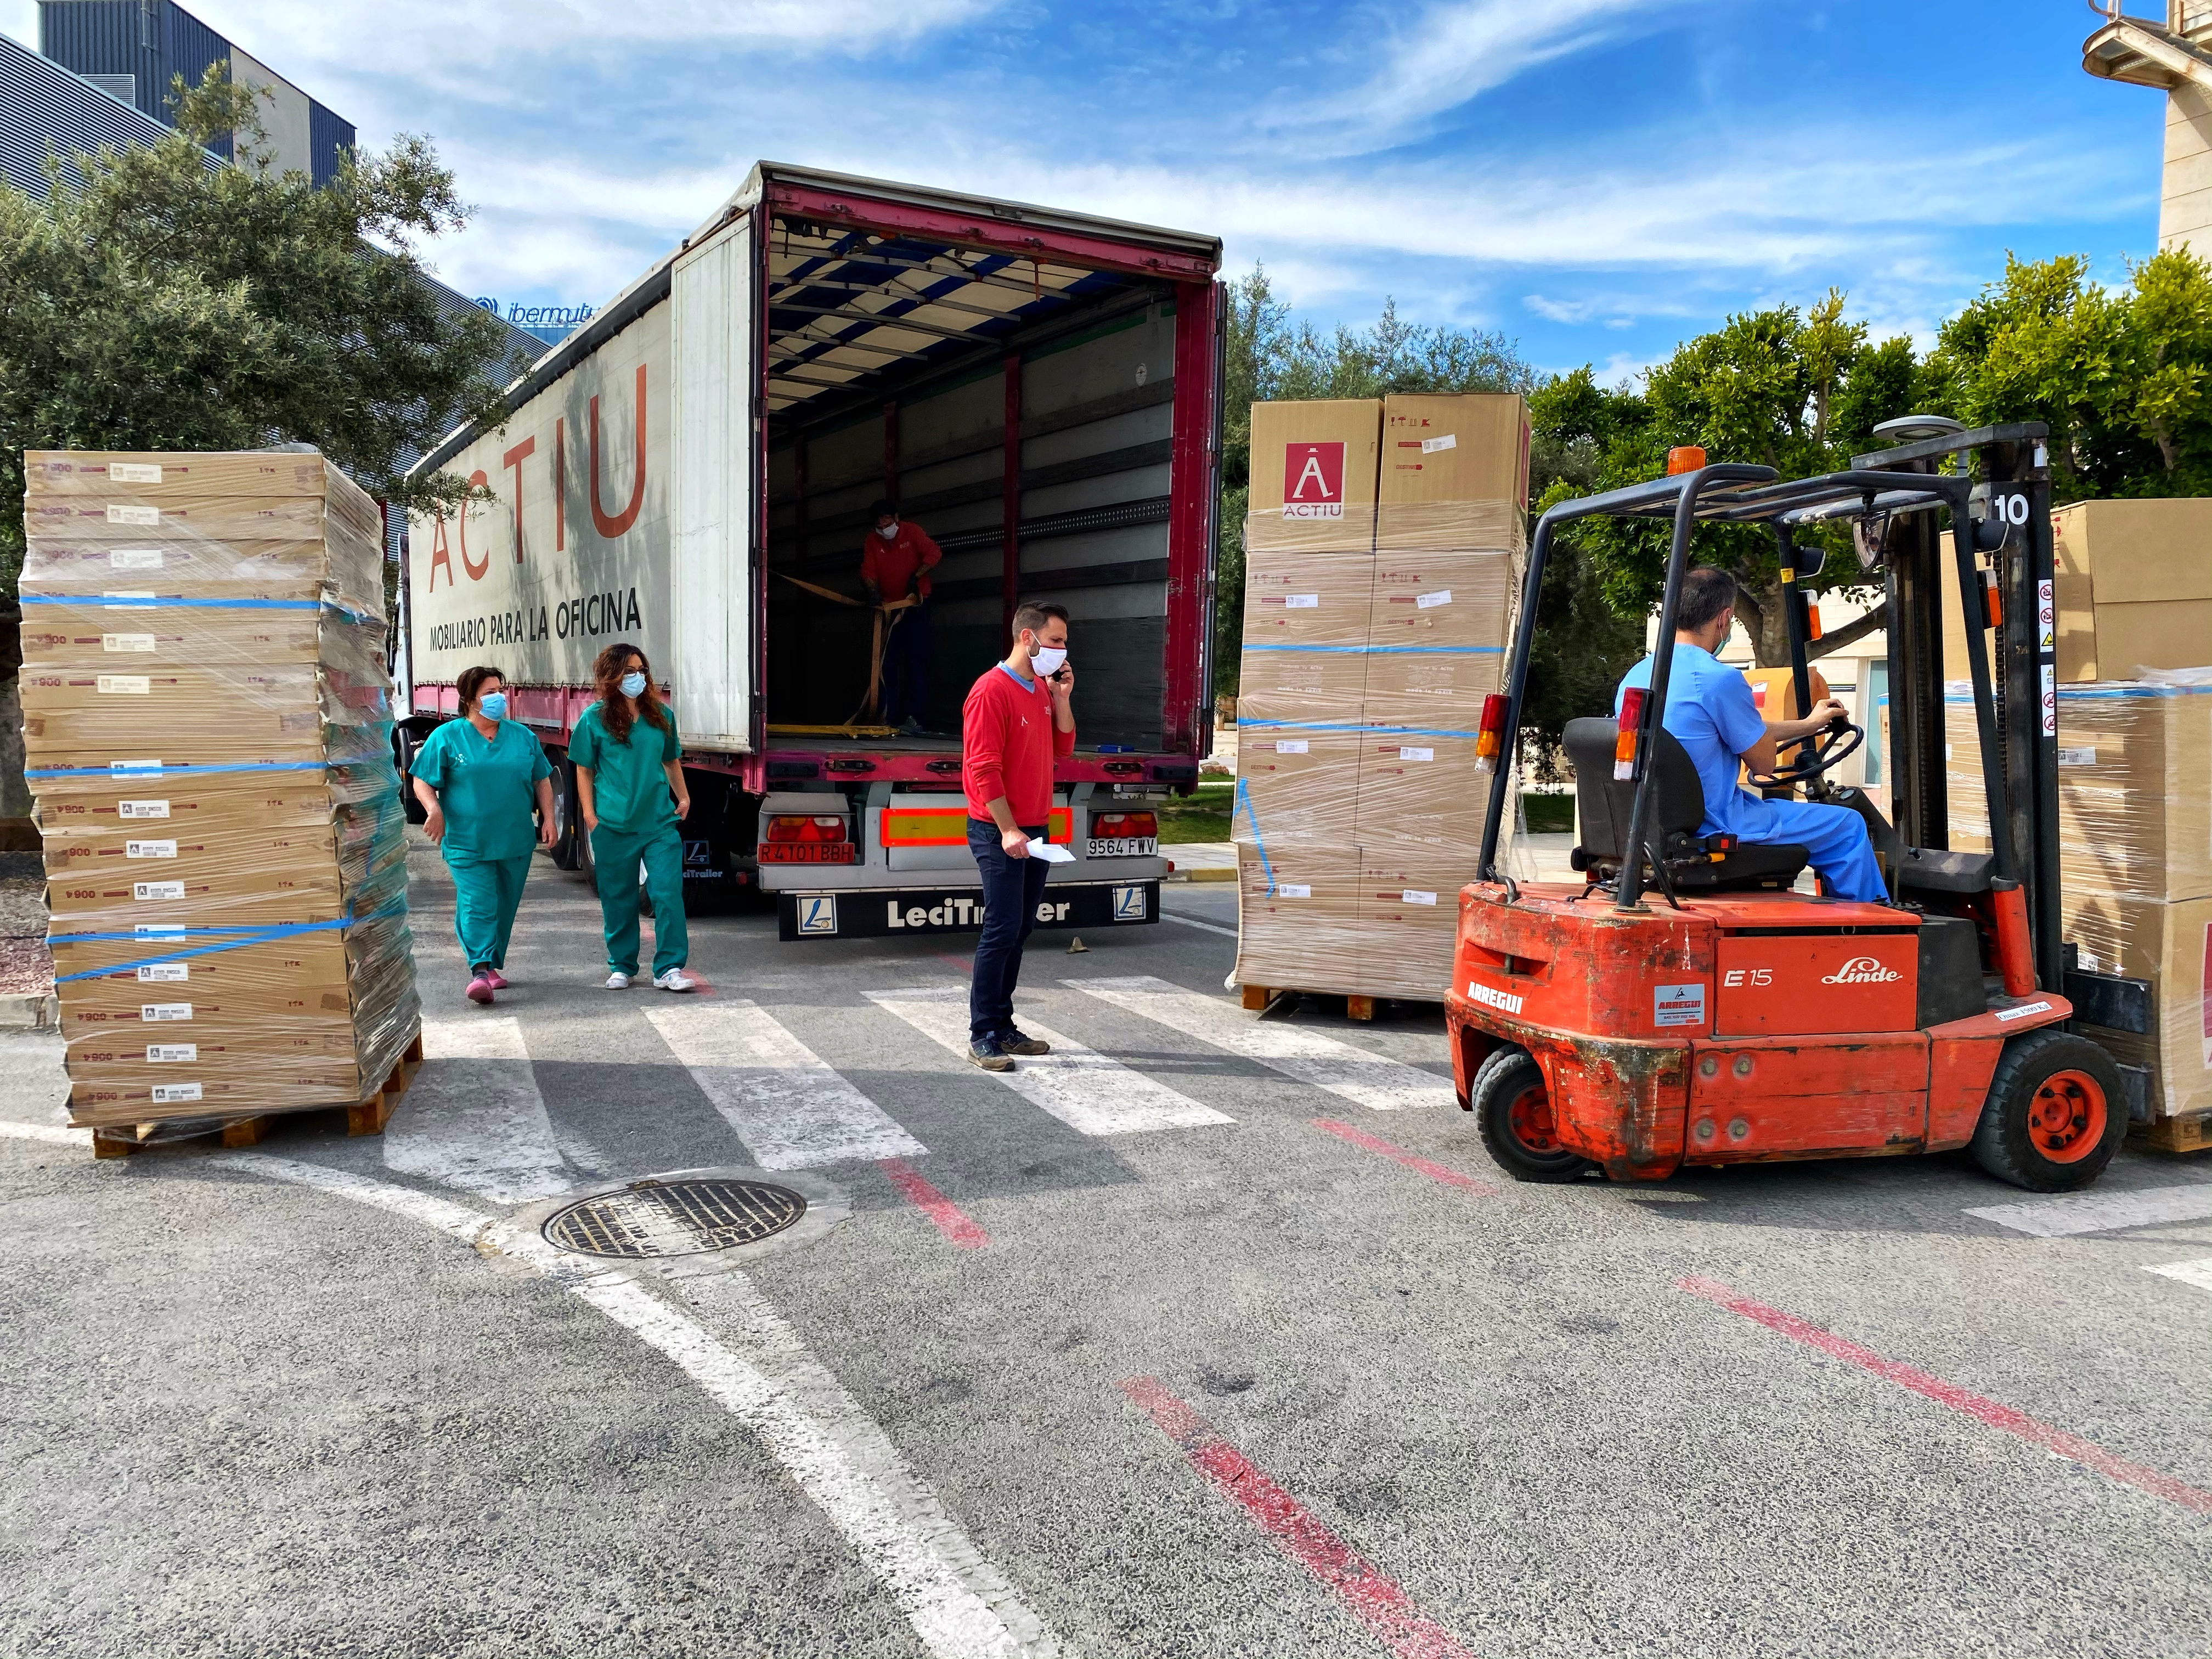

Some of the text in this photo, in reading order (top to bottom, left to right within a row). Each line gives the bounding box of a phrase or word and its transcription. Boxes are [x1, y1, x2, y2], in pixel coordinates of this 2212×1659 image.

[430, 363, 646, 593] ACTIU
[1284, 505, 1341, 516] ACTIU
[1994, 494, 2029, 525] 10
[430, 587, 642, 651] MOBILIARIO PARA LA OFICINA
[57, 805, 84, 813] 0064
[1089, 839, 1154, 854] 9564 FWV
[682, 868, 723, 878] ciTrailer
[66, 890, 95, 899] 0064
[888, 898, 1070, 928] LeciTrer
[1724, 969, 1773, 987] E 15
[1821, 957, 1903, 984] Linde
[1467, 981, 1523, 1014] ARREGUI
[1658, 1001, 1701, 1009] ARREGUI
